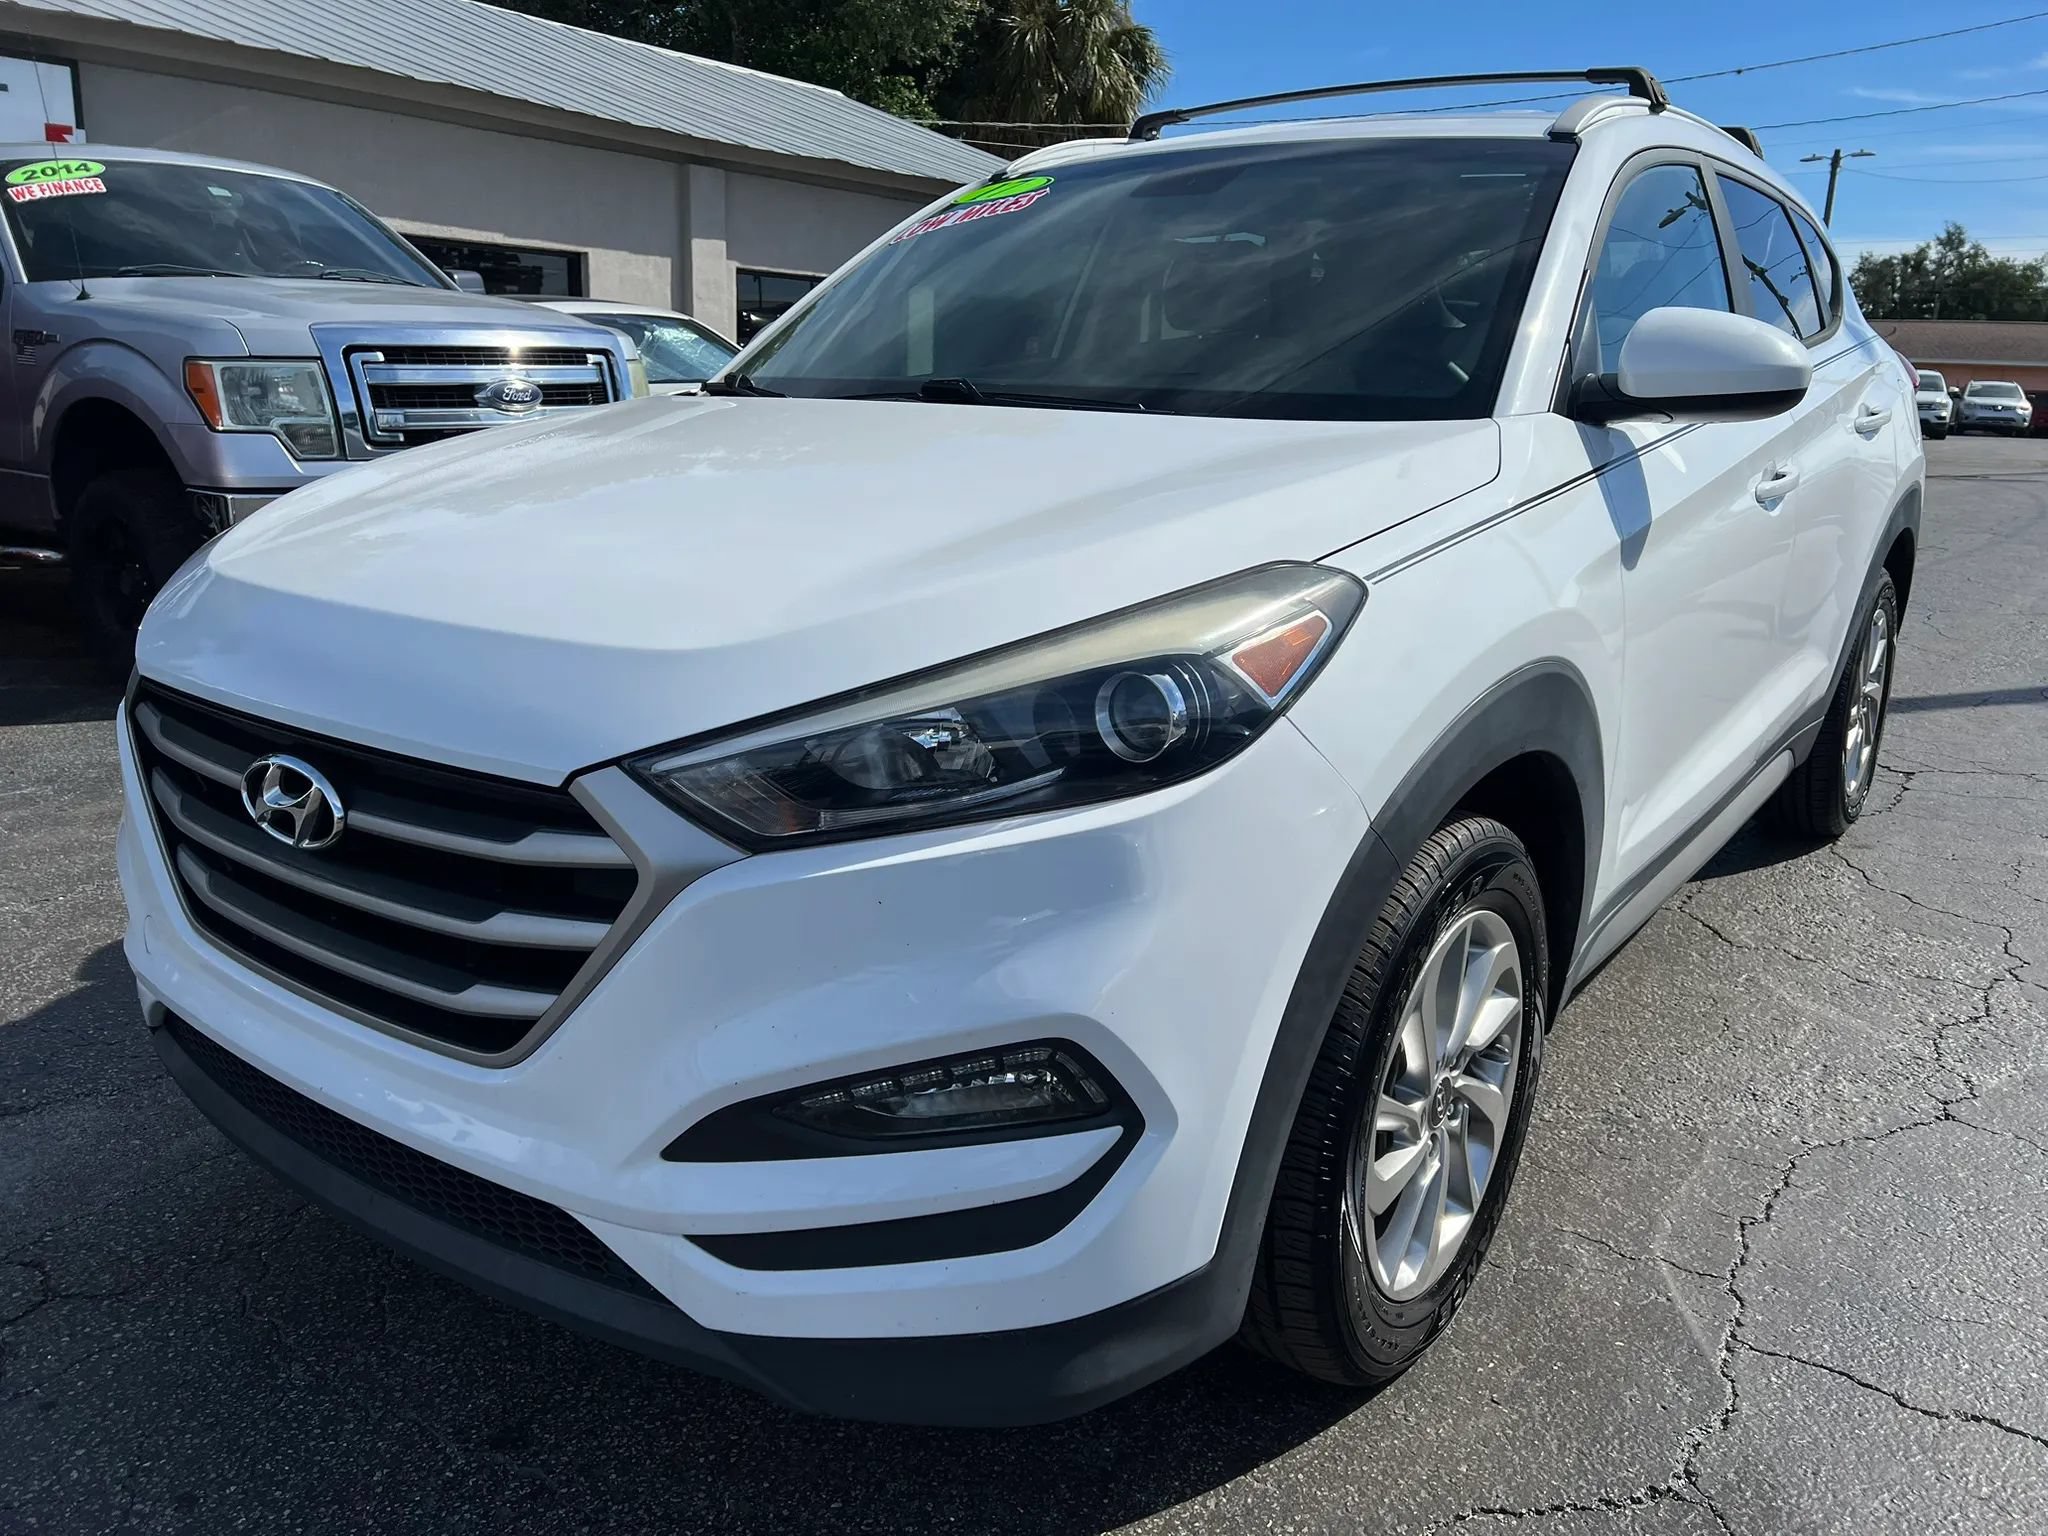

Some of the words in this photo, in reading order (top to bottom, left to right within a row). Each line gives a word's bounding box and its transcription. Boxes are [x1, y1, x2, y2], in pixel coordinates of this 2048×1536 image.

[21, 162, 93, 181] 2014
[11, 186, 37, 200] WE
[38, 180, 104, 195] FINANCE
[891, 212, 957, 244] LOW
[955, 189, 1049, 224] MILES
[502, 383, 533, 401] Ford
